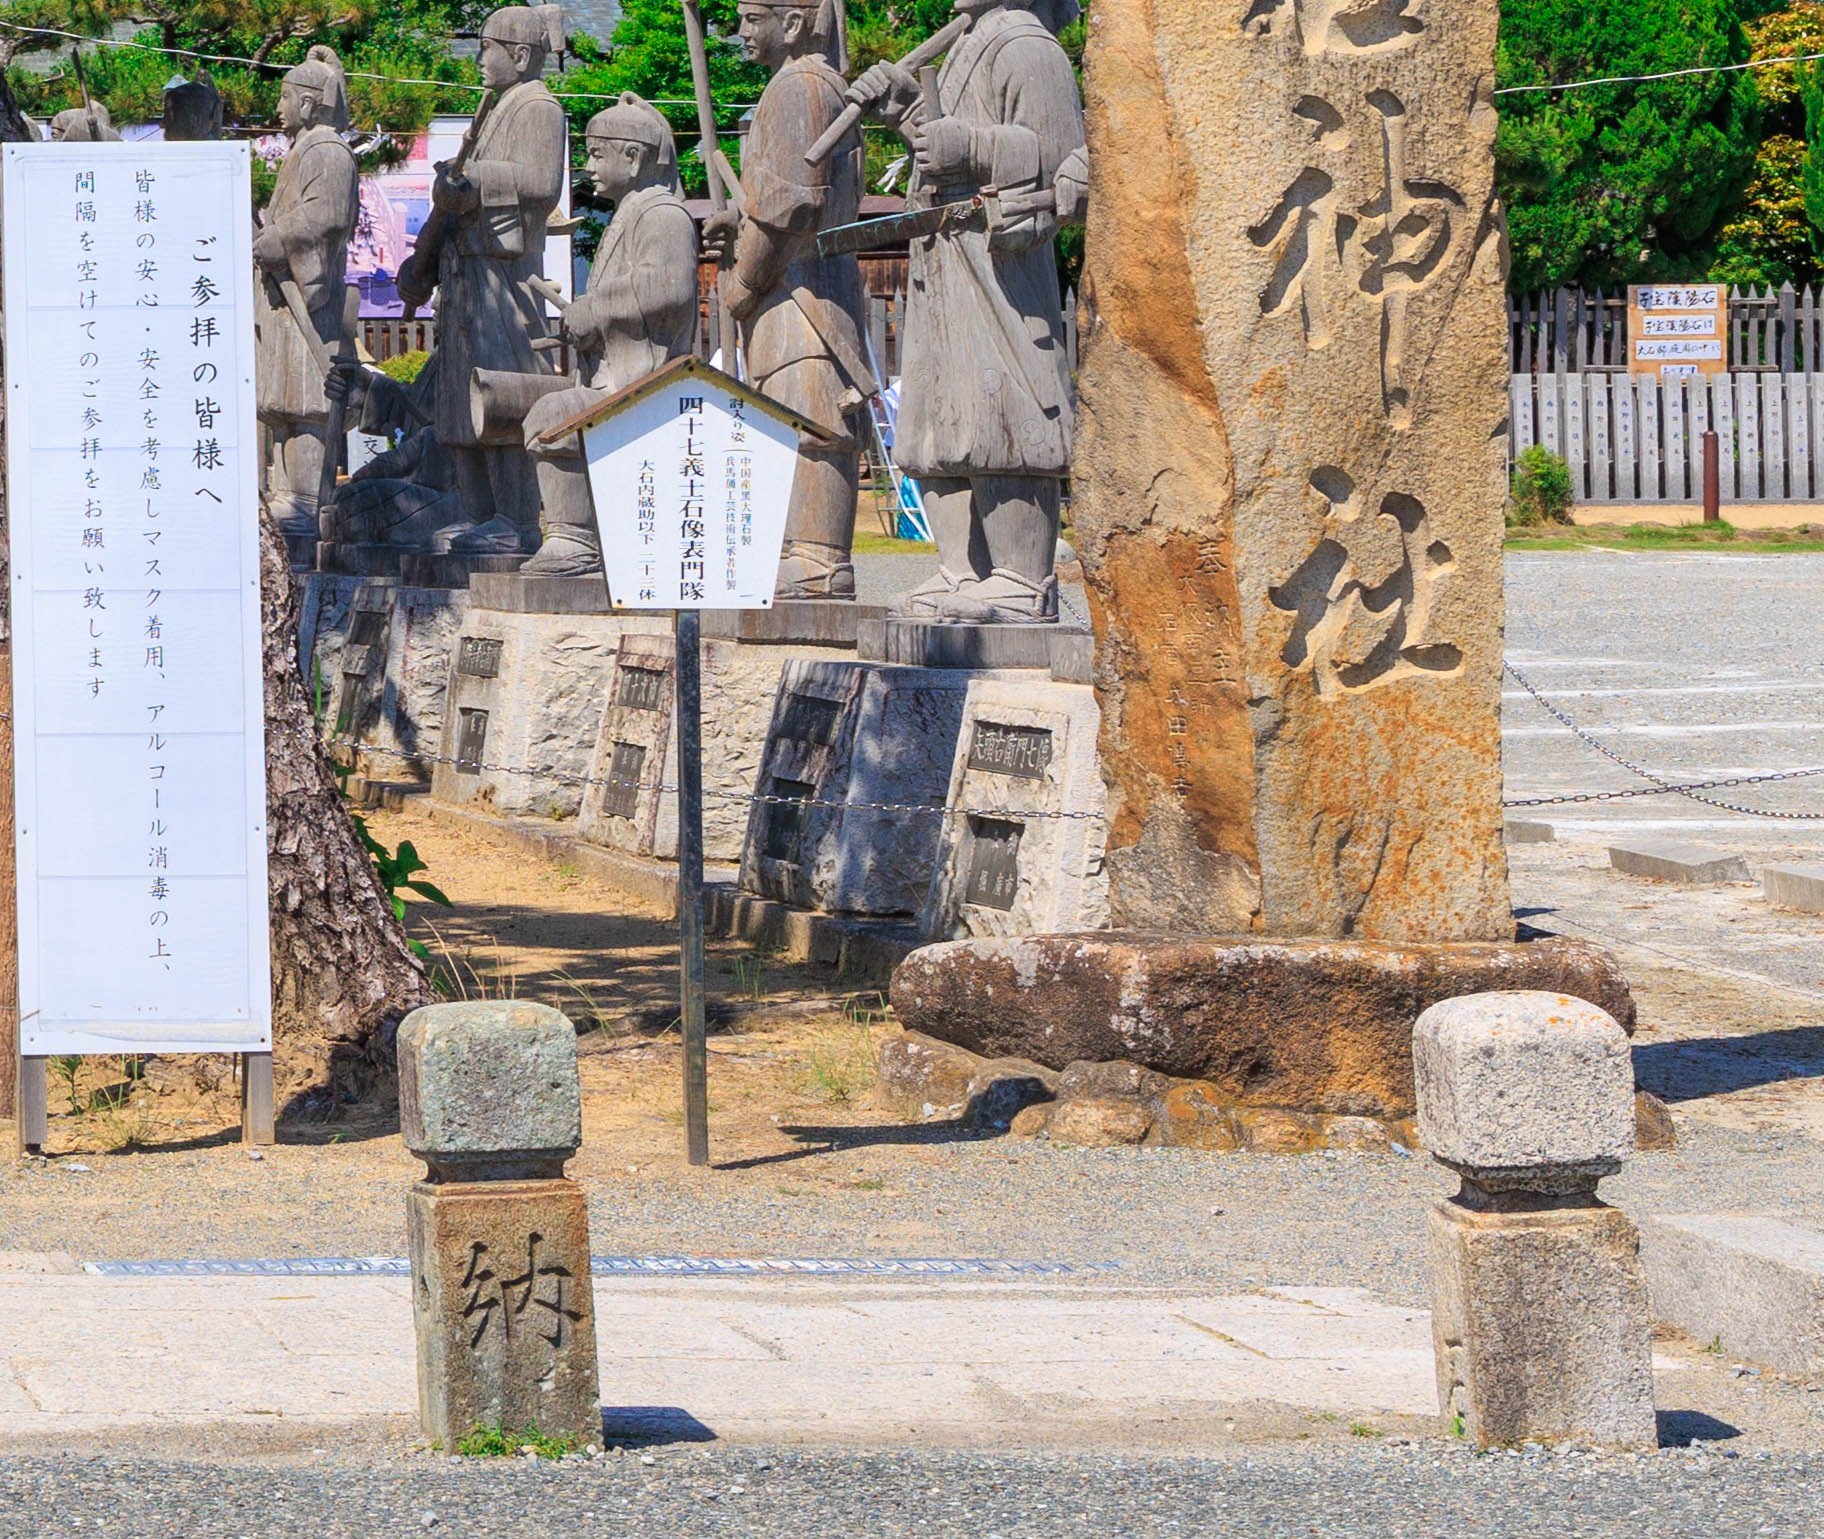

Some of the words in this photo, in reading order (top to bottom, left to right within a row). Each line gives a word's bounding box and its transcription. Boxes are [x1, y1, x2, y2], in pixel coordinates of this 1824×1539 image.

[74, 170, 106, 699] 間隔を空けてのご参拝をお願い致します
[189, 236, 224, 504] ご参拝の皆様へ
[729, 397, 746, 442] 討入り姿
[679, 396, 705, 601] 四十七義士石像表門隊
[462, 1232, 584, 1349] 納
